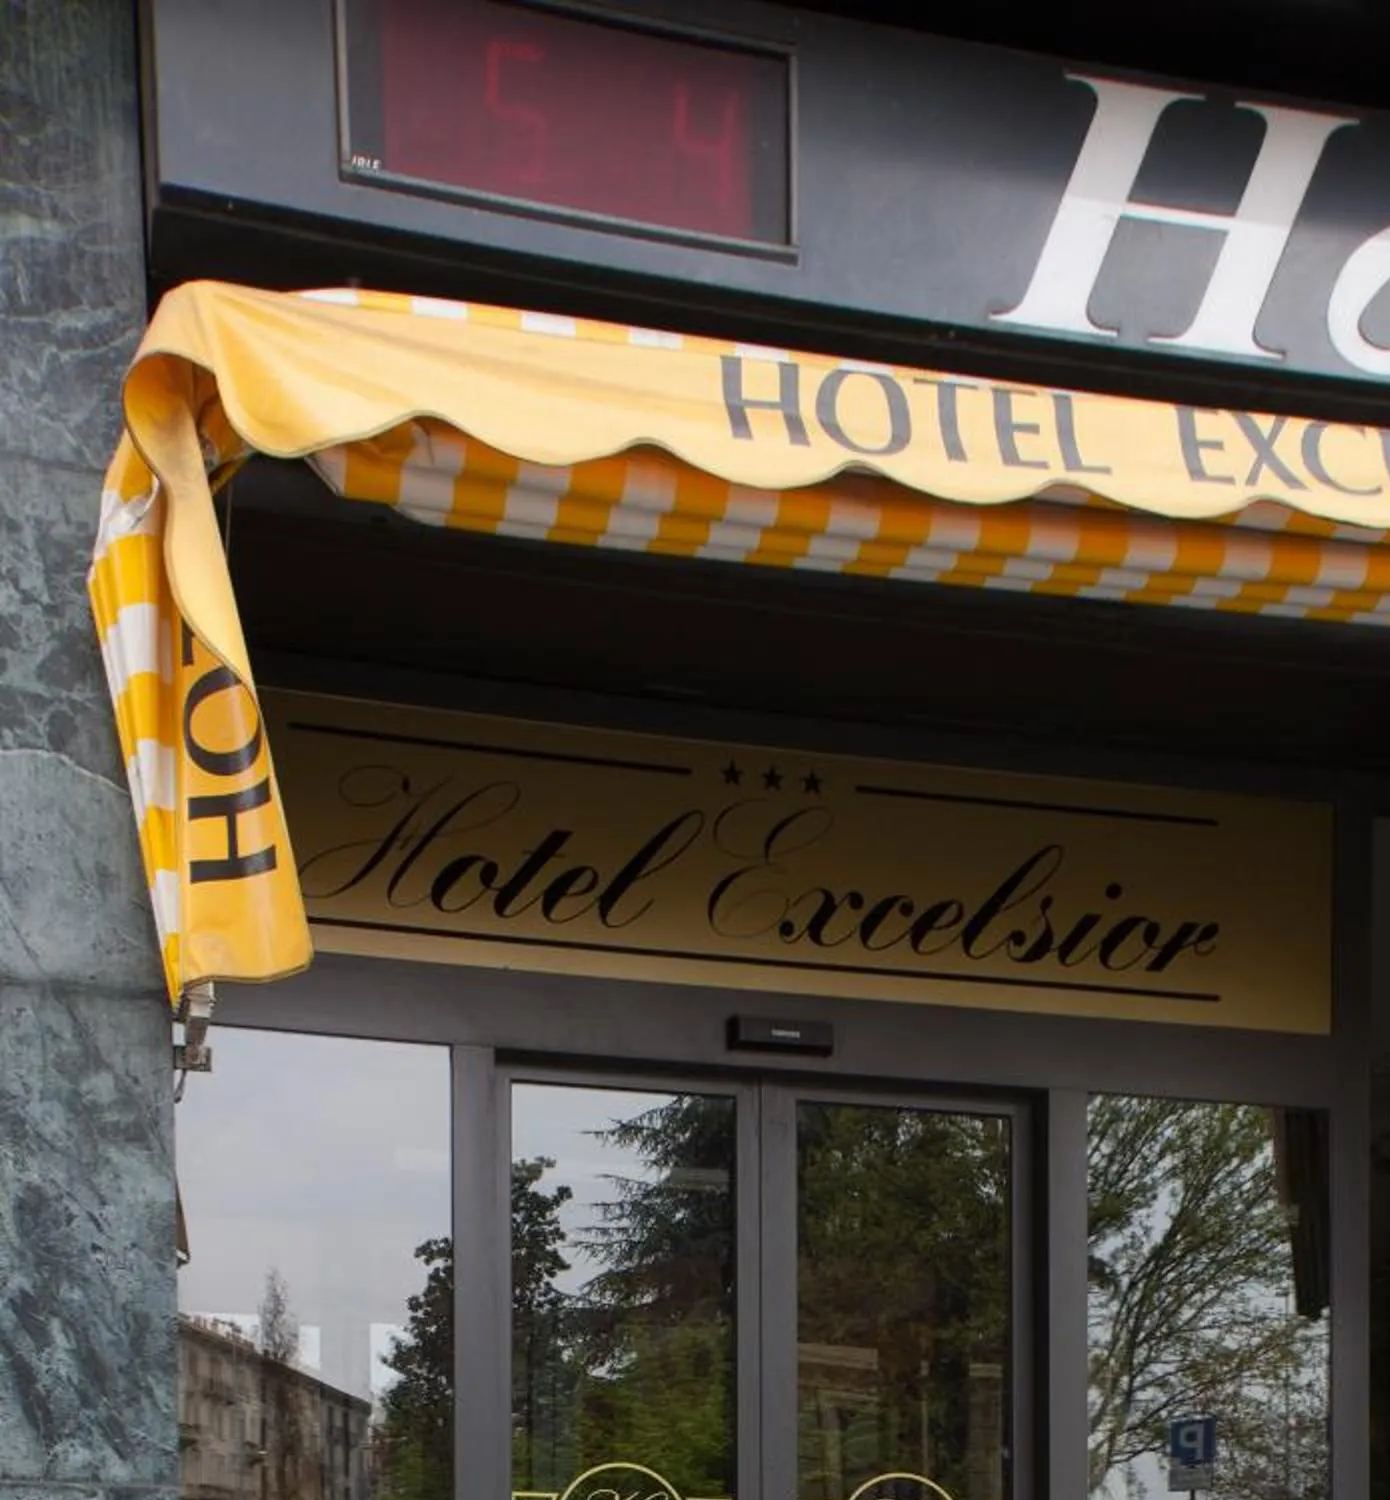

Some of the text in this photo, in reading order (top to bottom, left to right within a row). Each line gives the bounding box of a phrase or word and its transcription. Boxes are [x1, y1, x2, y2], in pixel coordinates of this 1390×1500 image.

[720, 354, 1112, 475] HOTEL
[301, 764, 1220, 973] Hotel Excelsior
